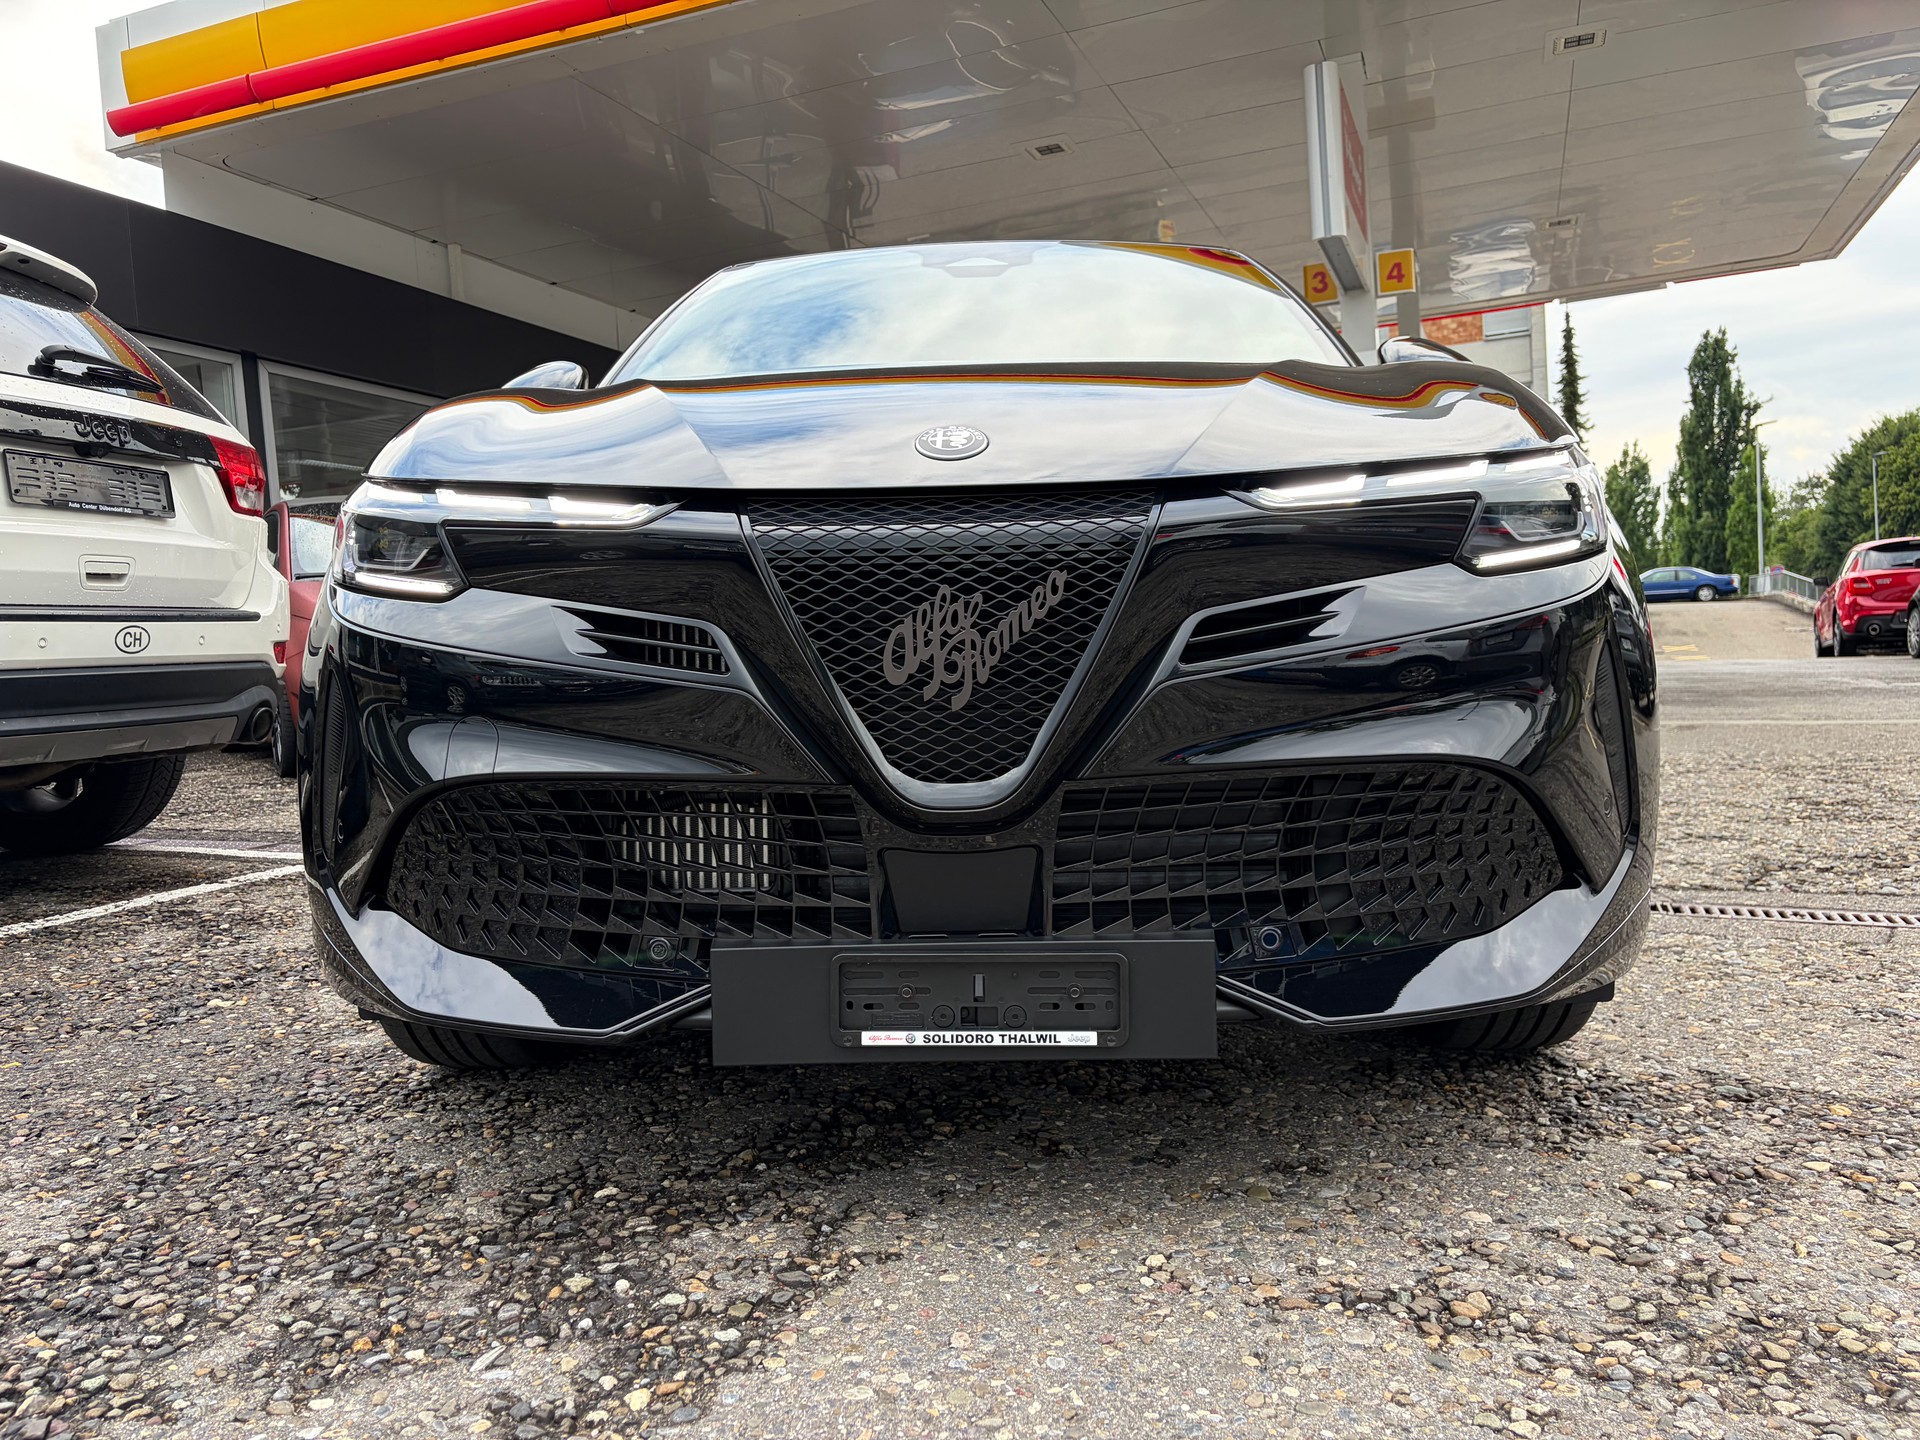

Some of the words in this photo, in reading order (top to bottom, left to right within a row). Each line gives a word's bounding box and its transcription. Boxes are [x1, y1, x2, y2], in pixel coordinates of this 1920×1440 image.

[1311, 271, 1329, 294] 3
[1386, 261, 1405, 283] 4
[74, 413, 132, 448] Jeep
[82, 502, 98, 510] Center
[123, 631, 143, 648] CH
[883, 584, 976, 702] Alfa
[944, 569, 1067, 712] Romeo
[922, 1033, 995, 1044] SOLIDORO
[998, 1033, 1061, 1044] THALWIL
[1067, 1033, 1091, 1044] Jeep
